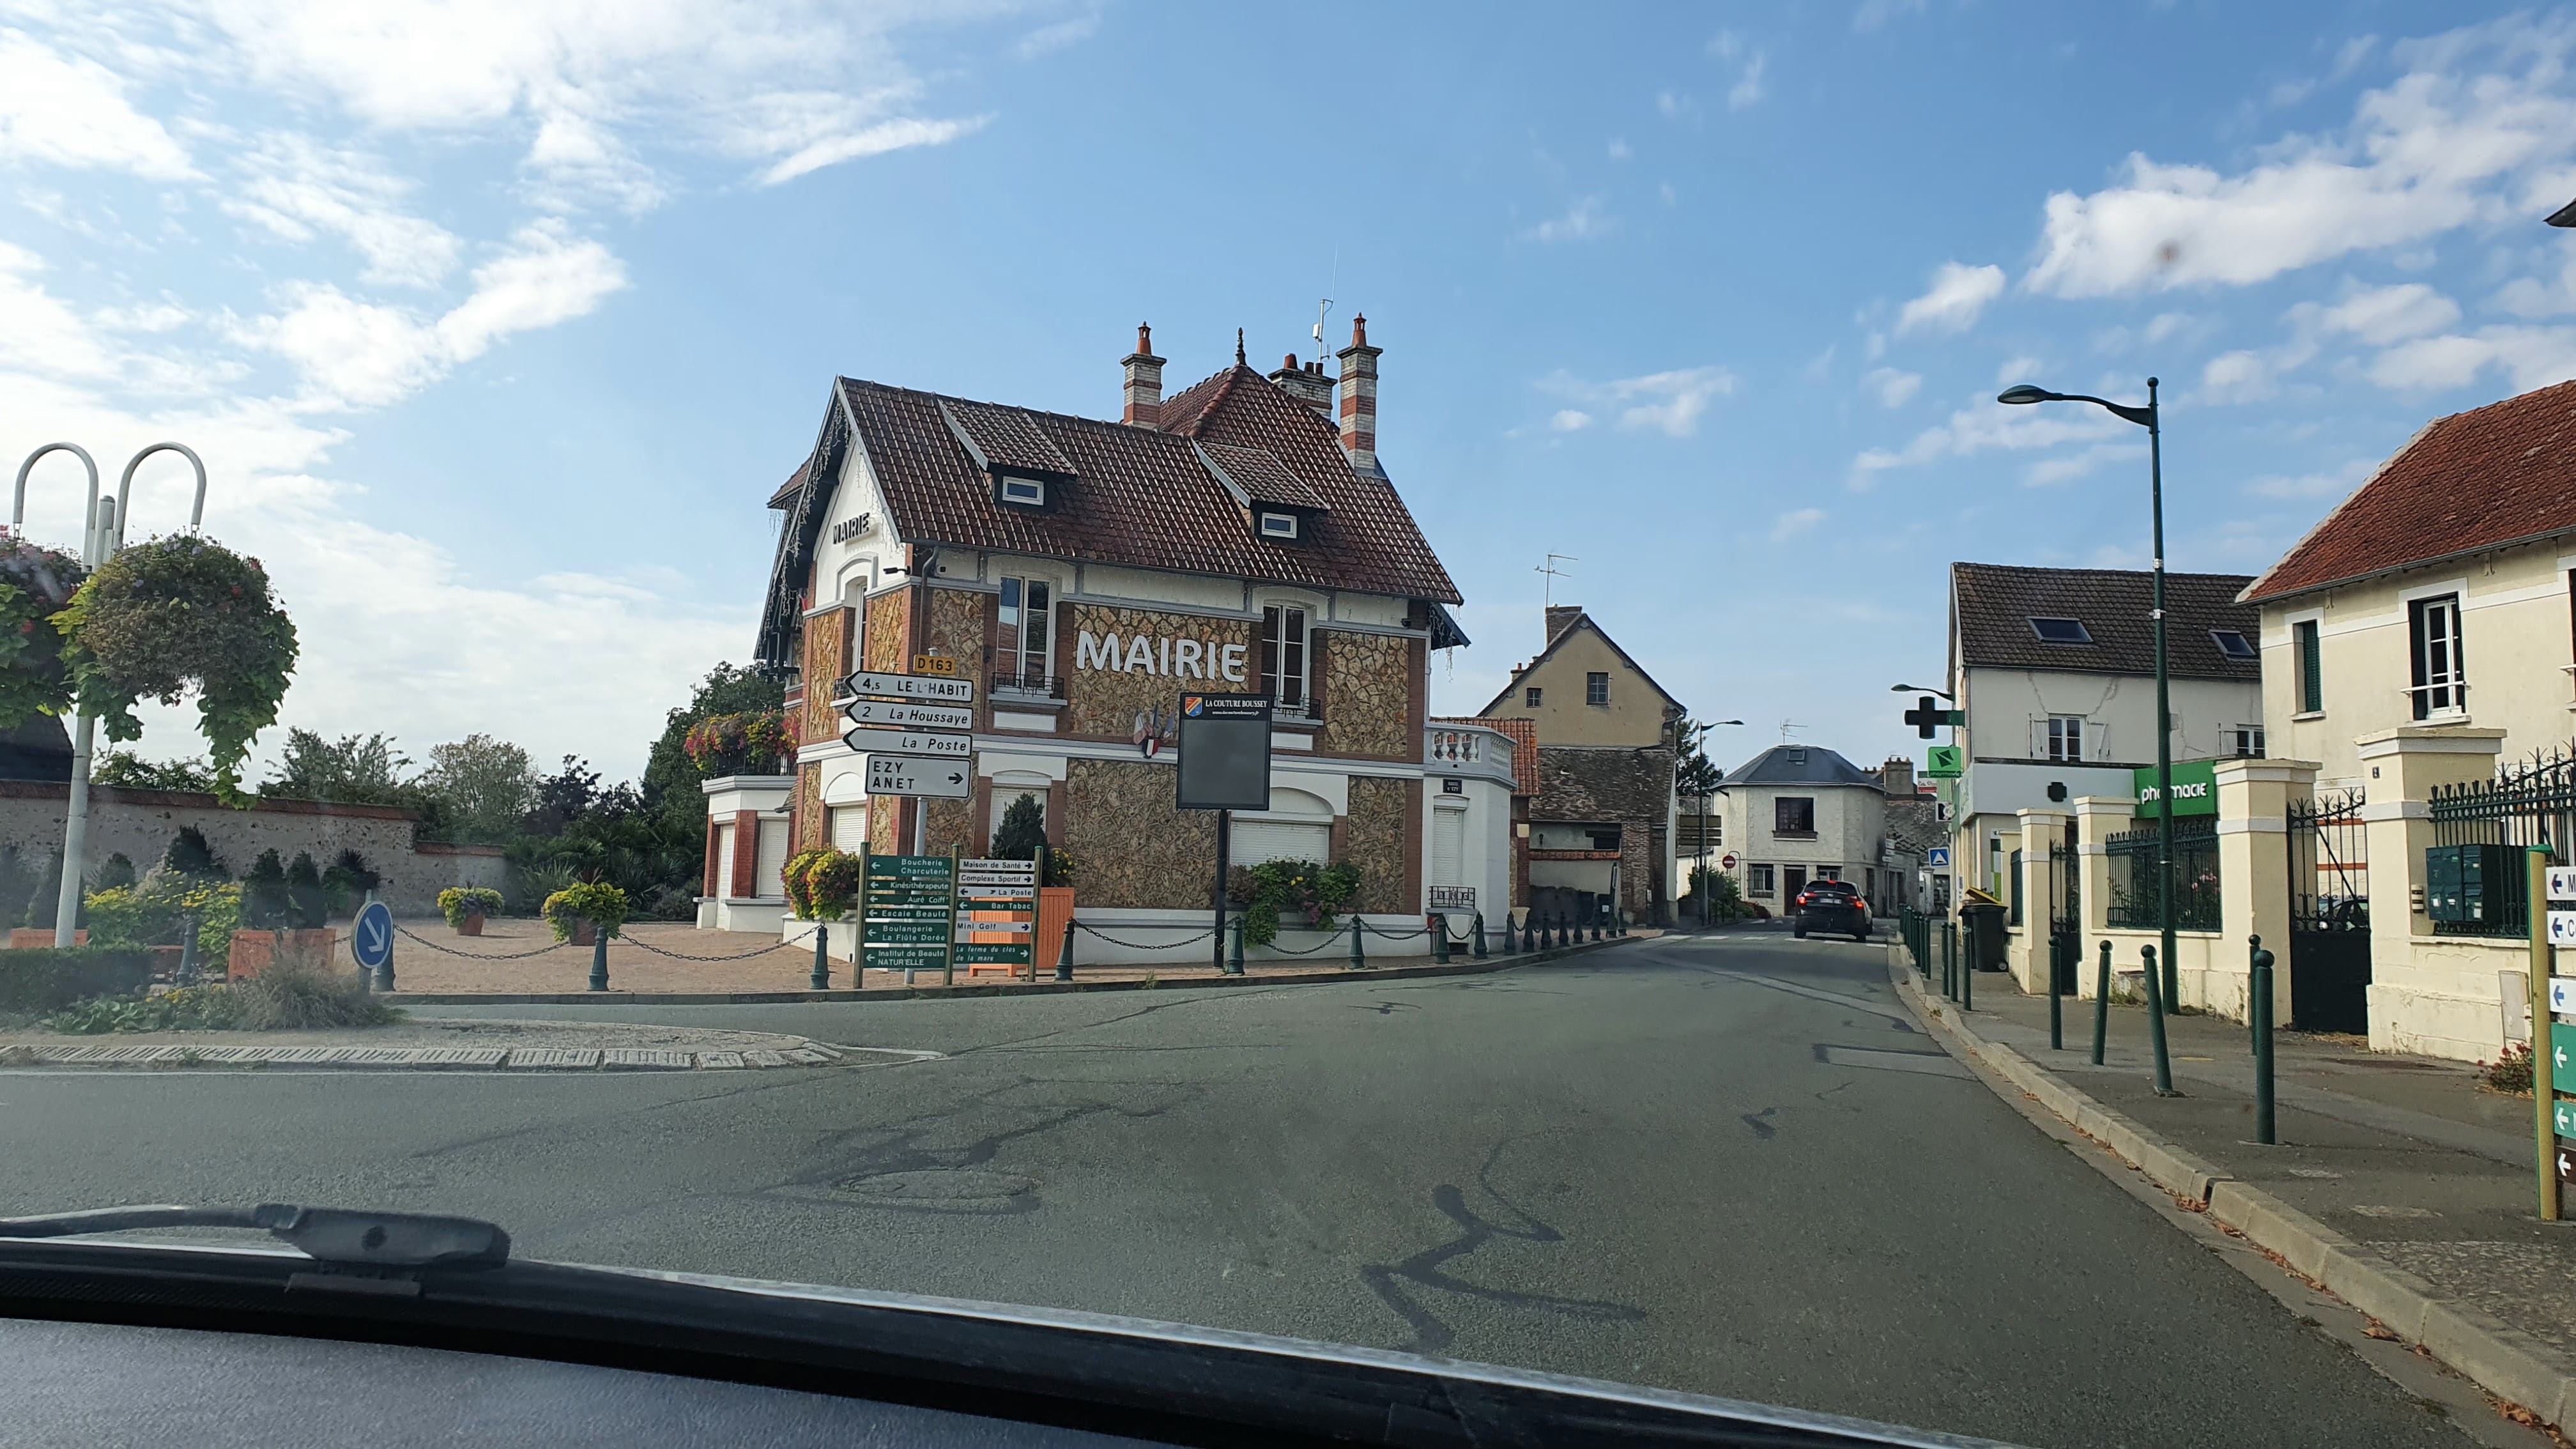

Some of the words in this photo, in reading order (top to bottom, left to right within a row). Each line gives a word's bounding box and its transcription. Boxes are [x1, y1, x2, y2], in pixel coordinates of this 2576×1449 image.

[833, 512, 870, 544] MAIRIE
[1076, 630, 1246, 682] MAIRIE
[917, 658, 926, 669] D
[929, 659, 953, 671] 163
[862, 678, 880, 691] 4,5
[898, 680, 913, 692] LE
[917, 682, 967, 696] L'HABIT
[862, 707, 871, 717] 2
[889, 708, 903, 719] La
[909, 710, 968, 725] Houssaye
[902, 737, 917, 748] La
[928, 739, 967, 751] Poste
[873, 761, 903, 774] EZY
[872, 776, 915, 790] ANET
[2142, 783, 2207, 804] phmacie
[890, 882, 949, 890] Kinésithérapeute
